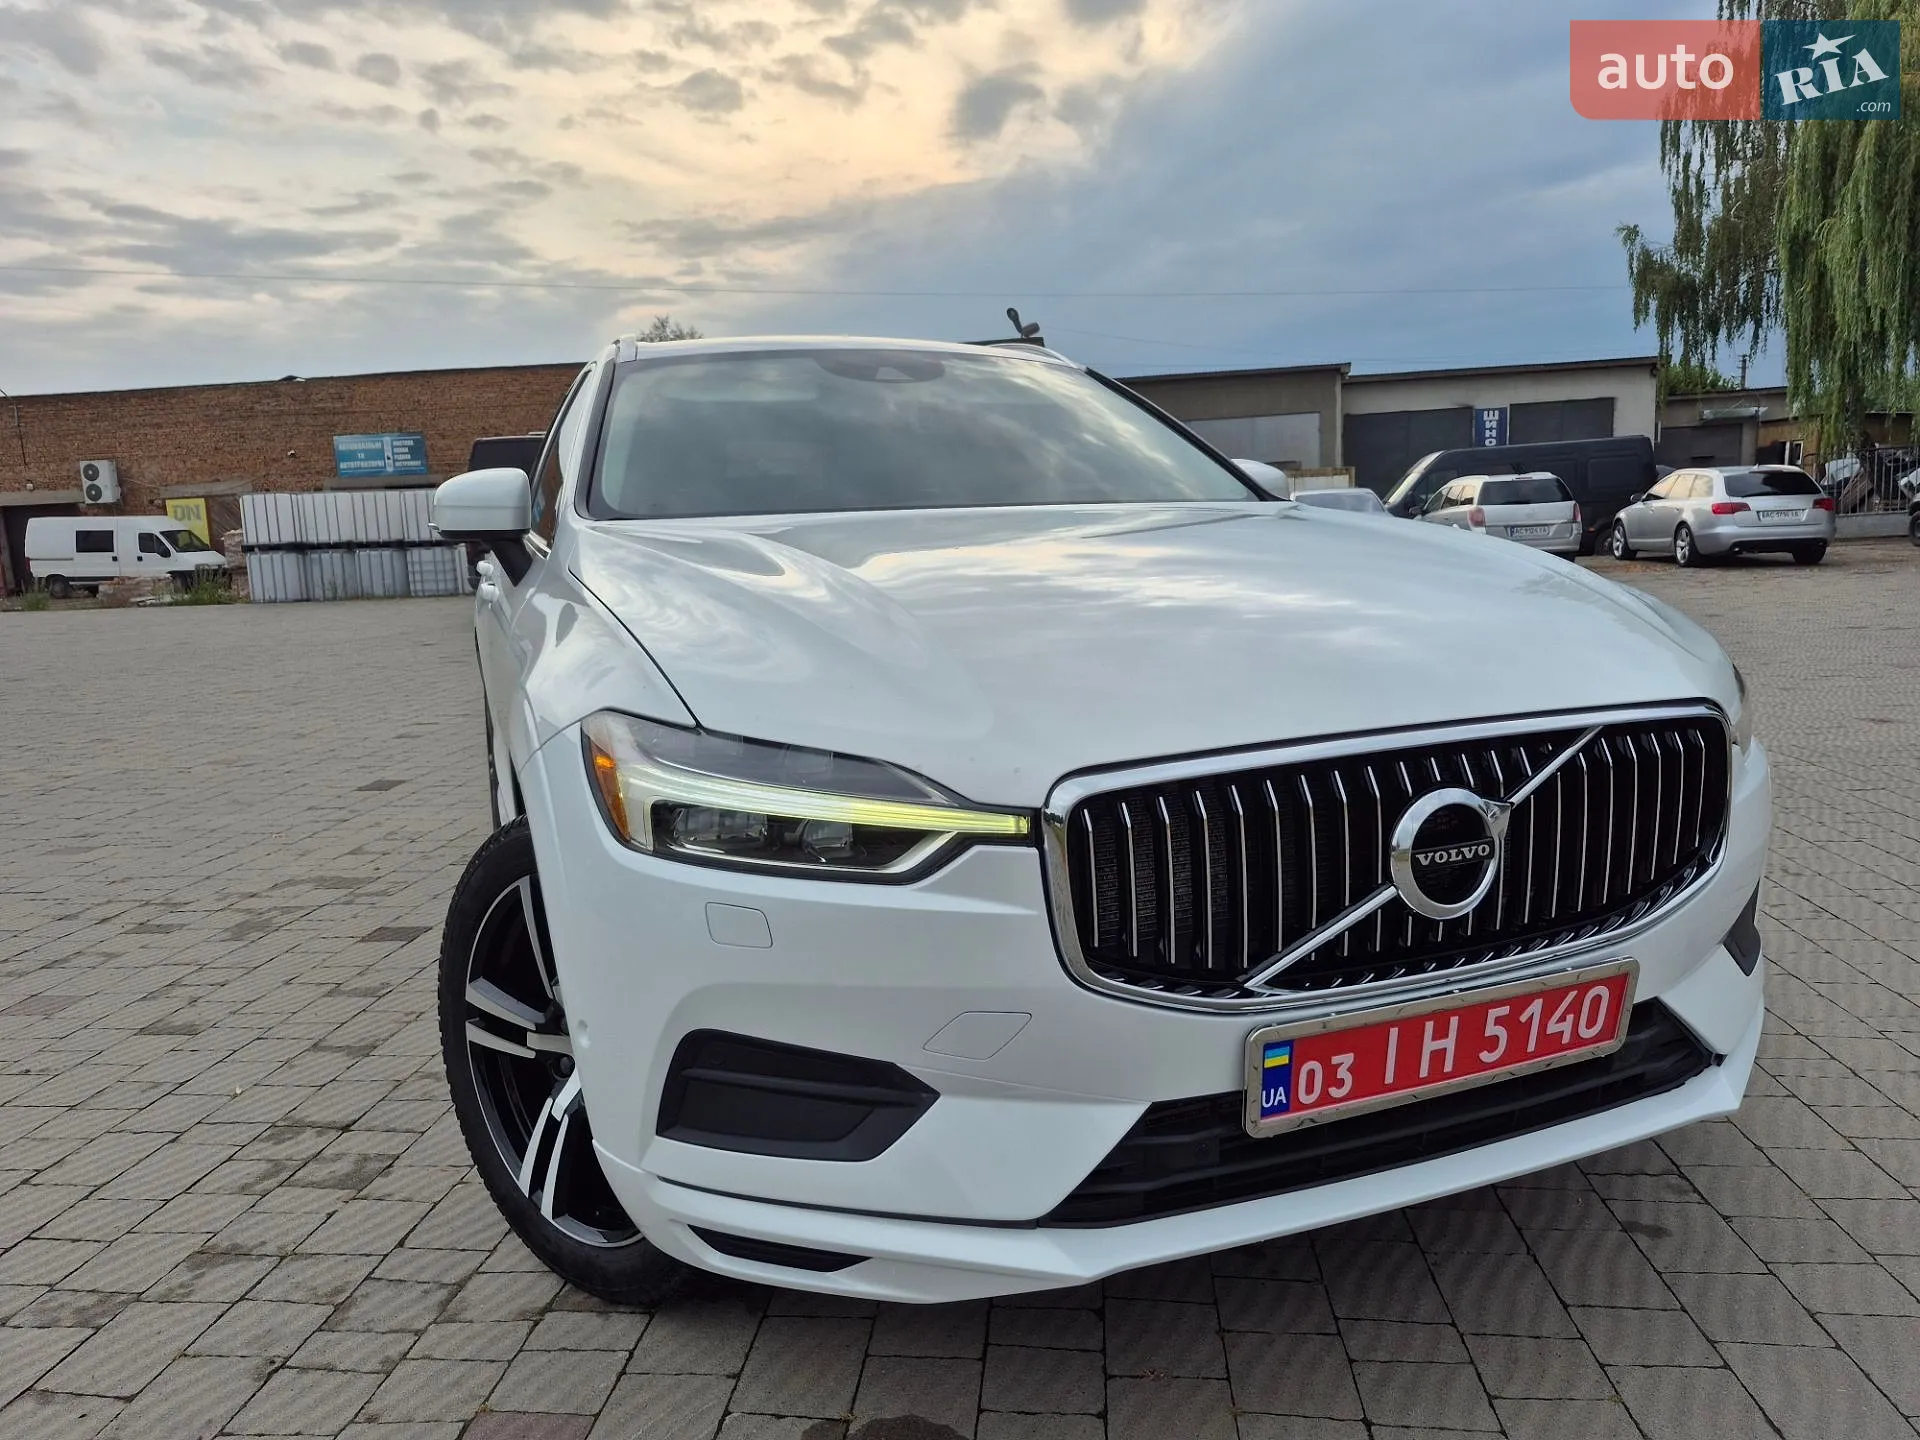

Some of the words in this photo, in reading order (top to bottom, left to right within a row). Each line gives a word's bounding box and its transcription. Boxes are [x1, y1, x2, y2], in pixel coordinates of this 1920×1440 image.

[1415, 844, 1490, 866] VOLVO
[1298, 1052, 1354, 1105] 03
[1478, 985, 1610, 1063] 5140
[1262, 1086, 1287, 1108] UA
